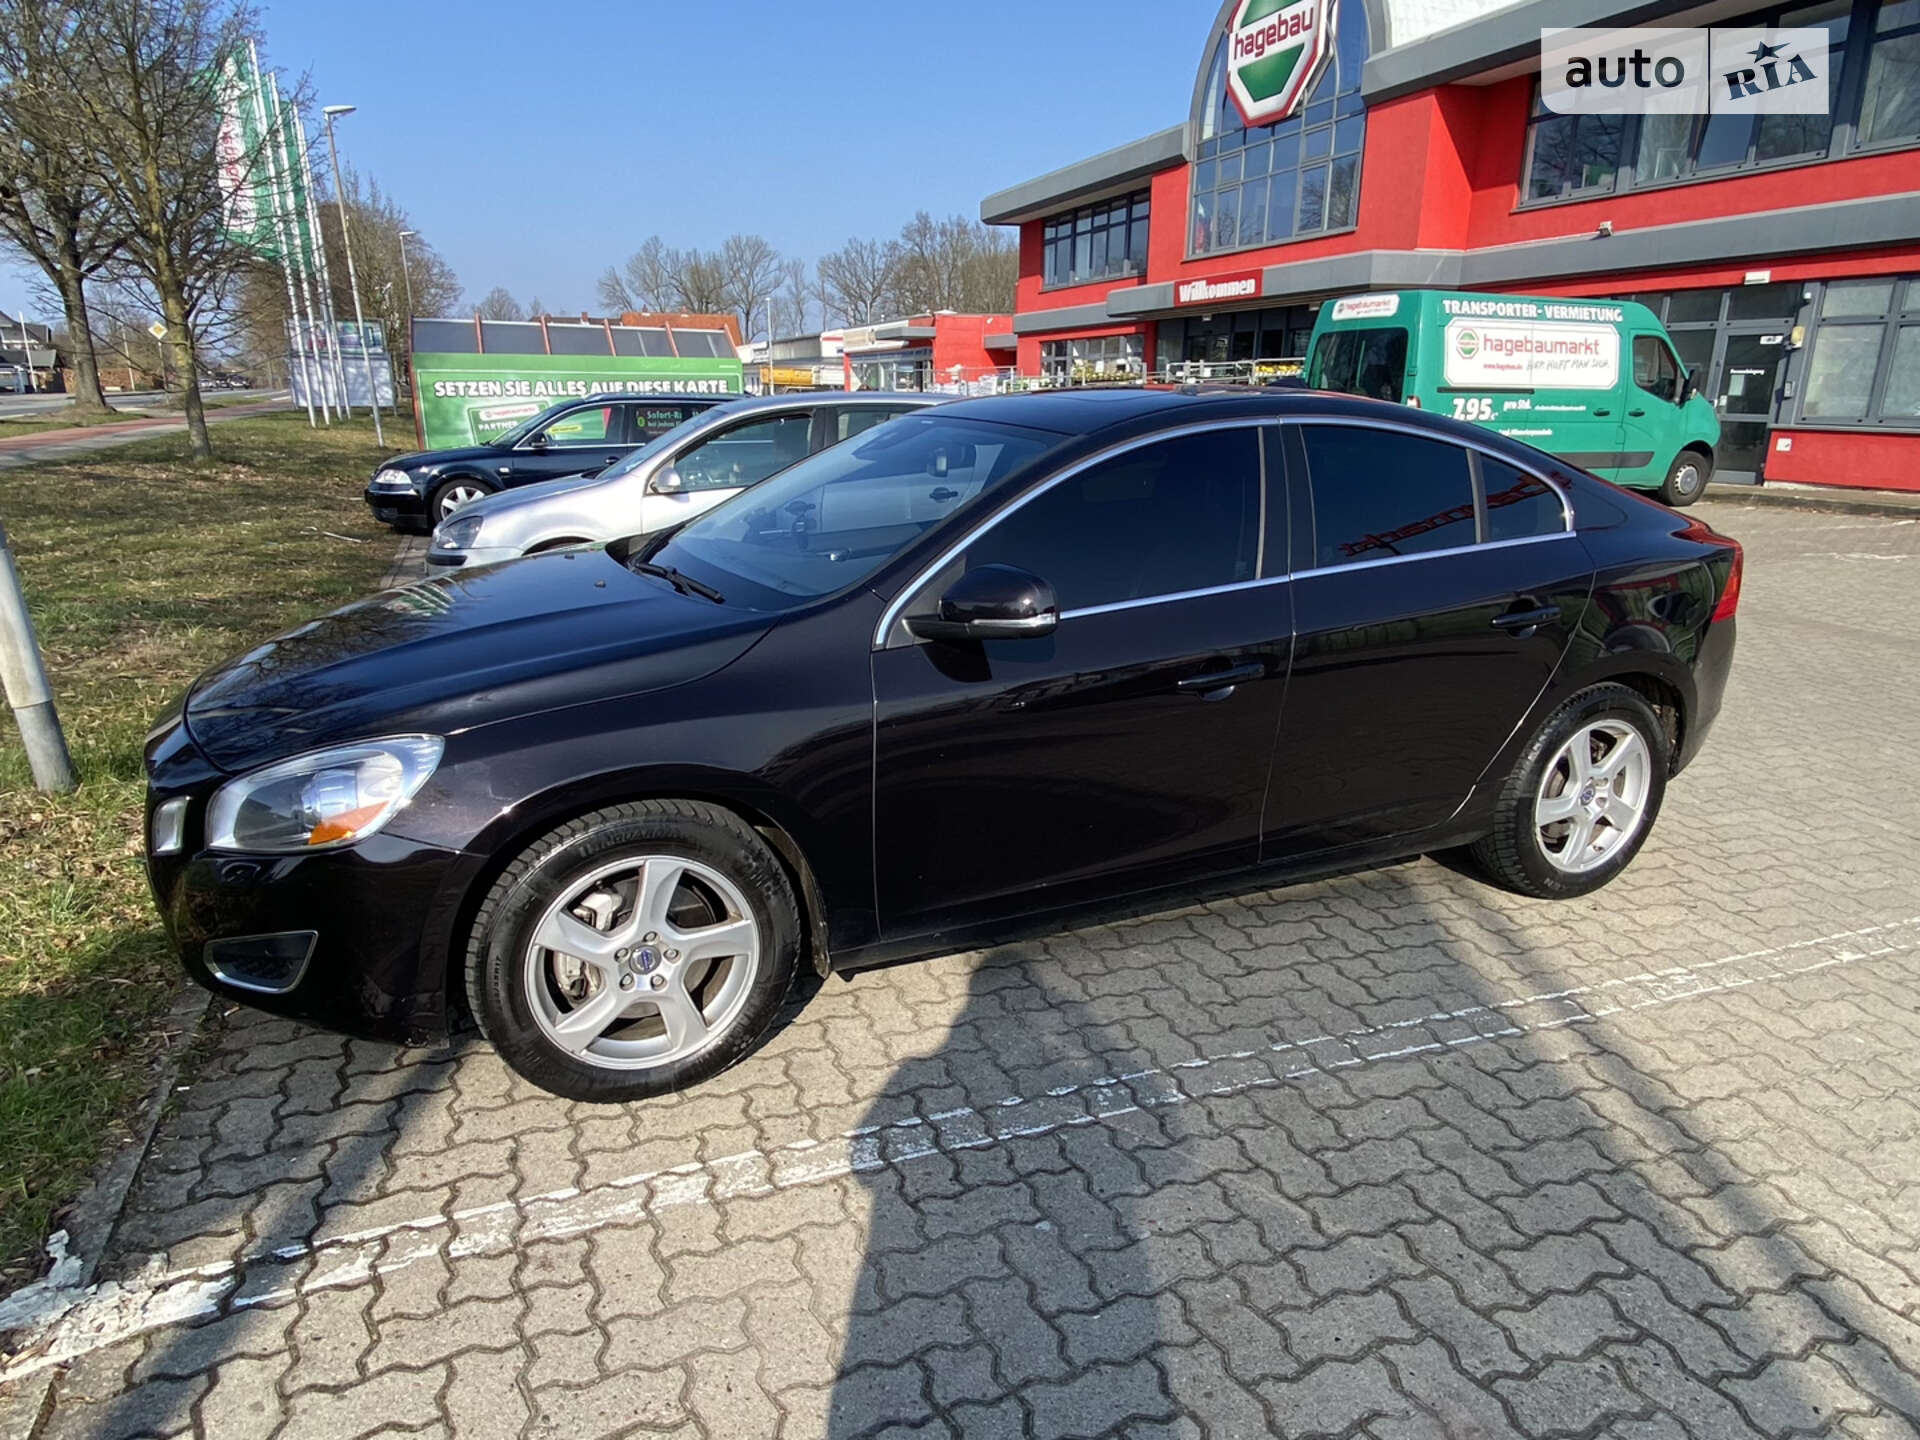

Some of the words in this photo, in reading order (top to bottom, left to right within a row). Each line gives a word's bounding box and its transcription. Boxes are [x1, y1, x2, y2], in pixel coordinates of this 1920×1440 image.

[1234, 7, 1314, 60] hagebau
[1179, 278, 1256, 303] Willkommen
[1483, 334, 1599, 356] hagebaumarkt
[434, 381, 501, 397] SETZEN
[505, 381, 531, 396] SIE
[535, 380, 586, 396] ALLES
[590, 381, 624, 394] AUF
[626, 380, 671, 394] DIESE
[673, 379, 728, 393] KARTE
[1503, 400, 1517, 411] pro
